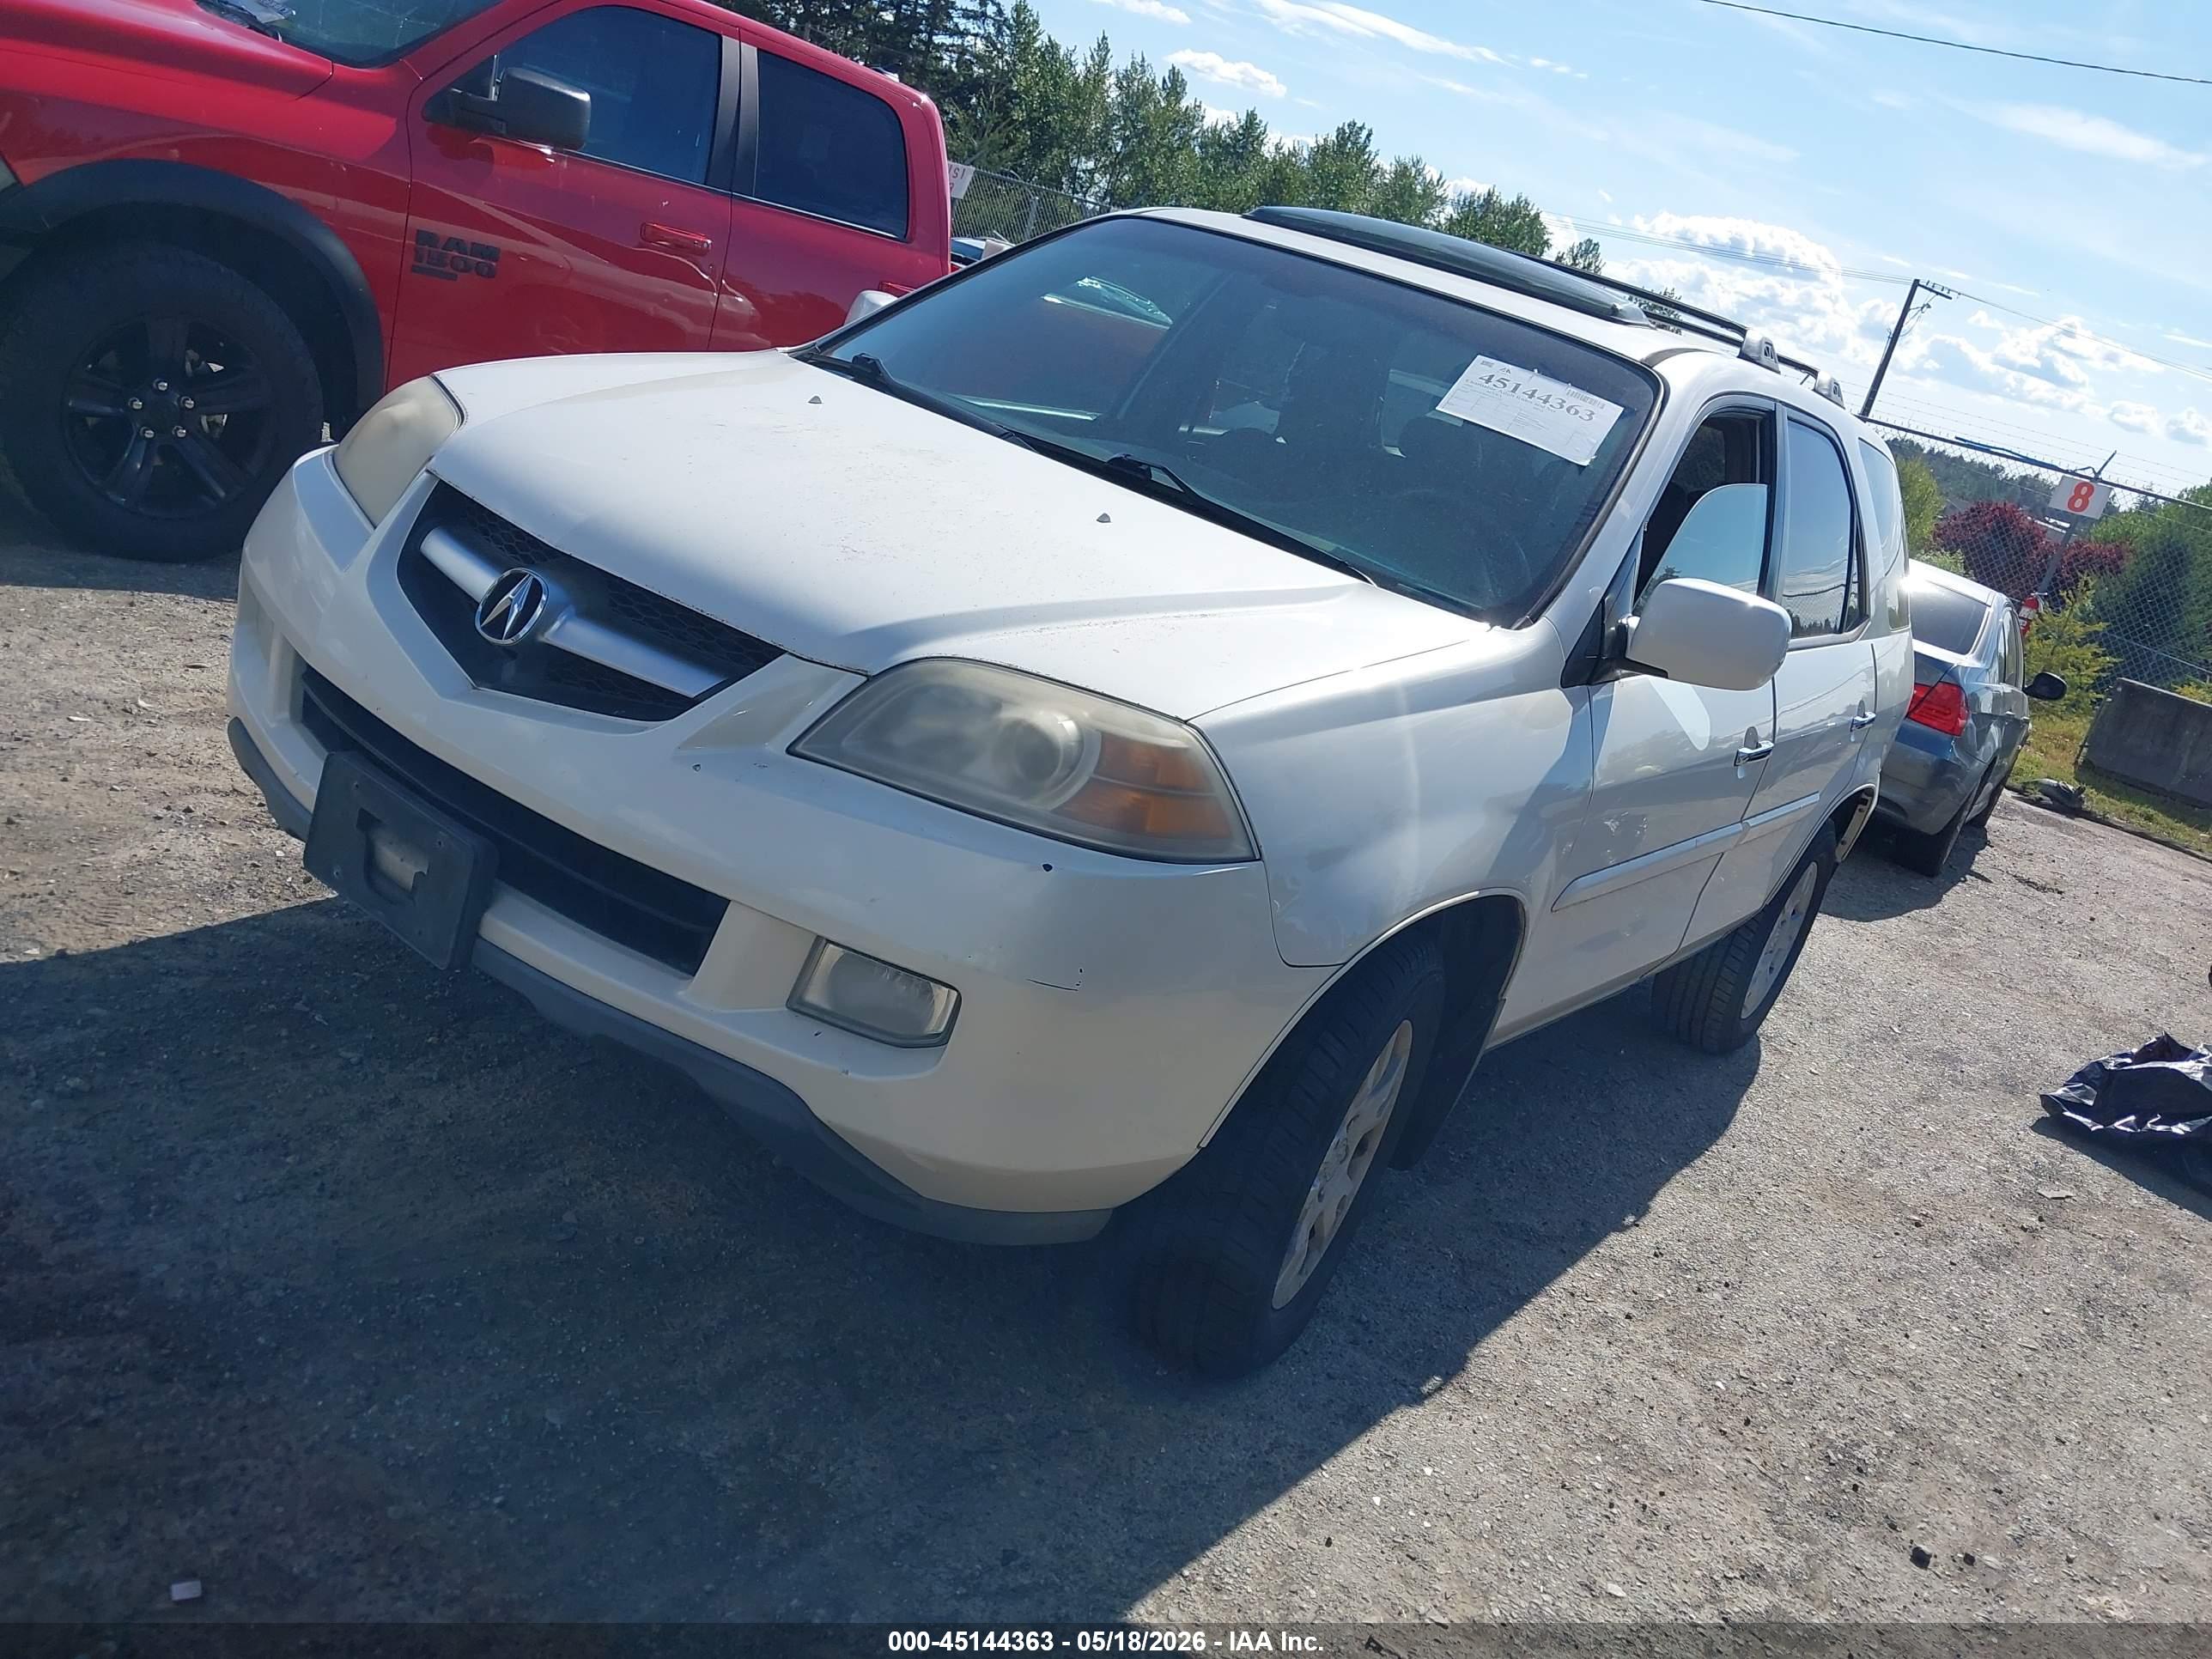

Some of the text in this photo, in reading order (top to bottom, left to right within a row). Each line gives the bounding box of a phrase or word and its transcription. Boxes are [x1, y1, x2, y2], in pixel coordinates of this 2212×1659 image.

[416, 229, 501, 262] RAM
[414, 246, 496, 278] 1500
[1479, 374, 1595, 421] 45144363
[2067, 481, 2095, 513] 8
